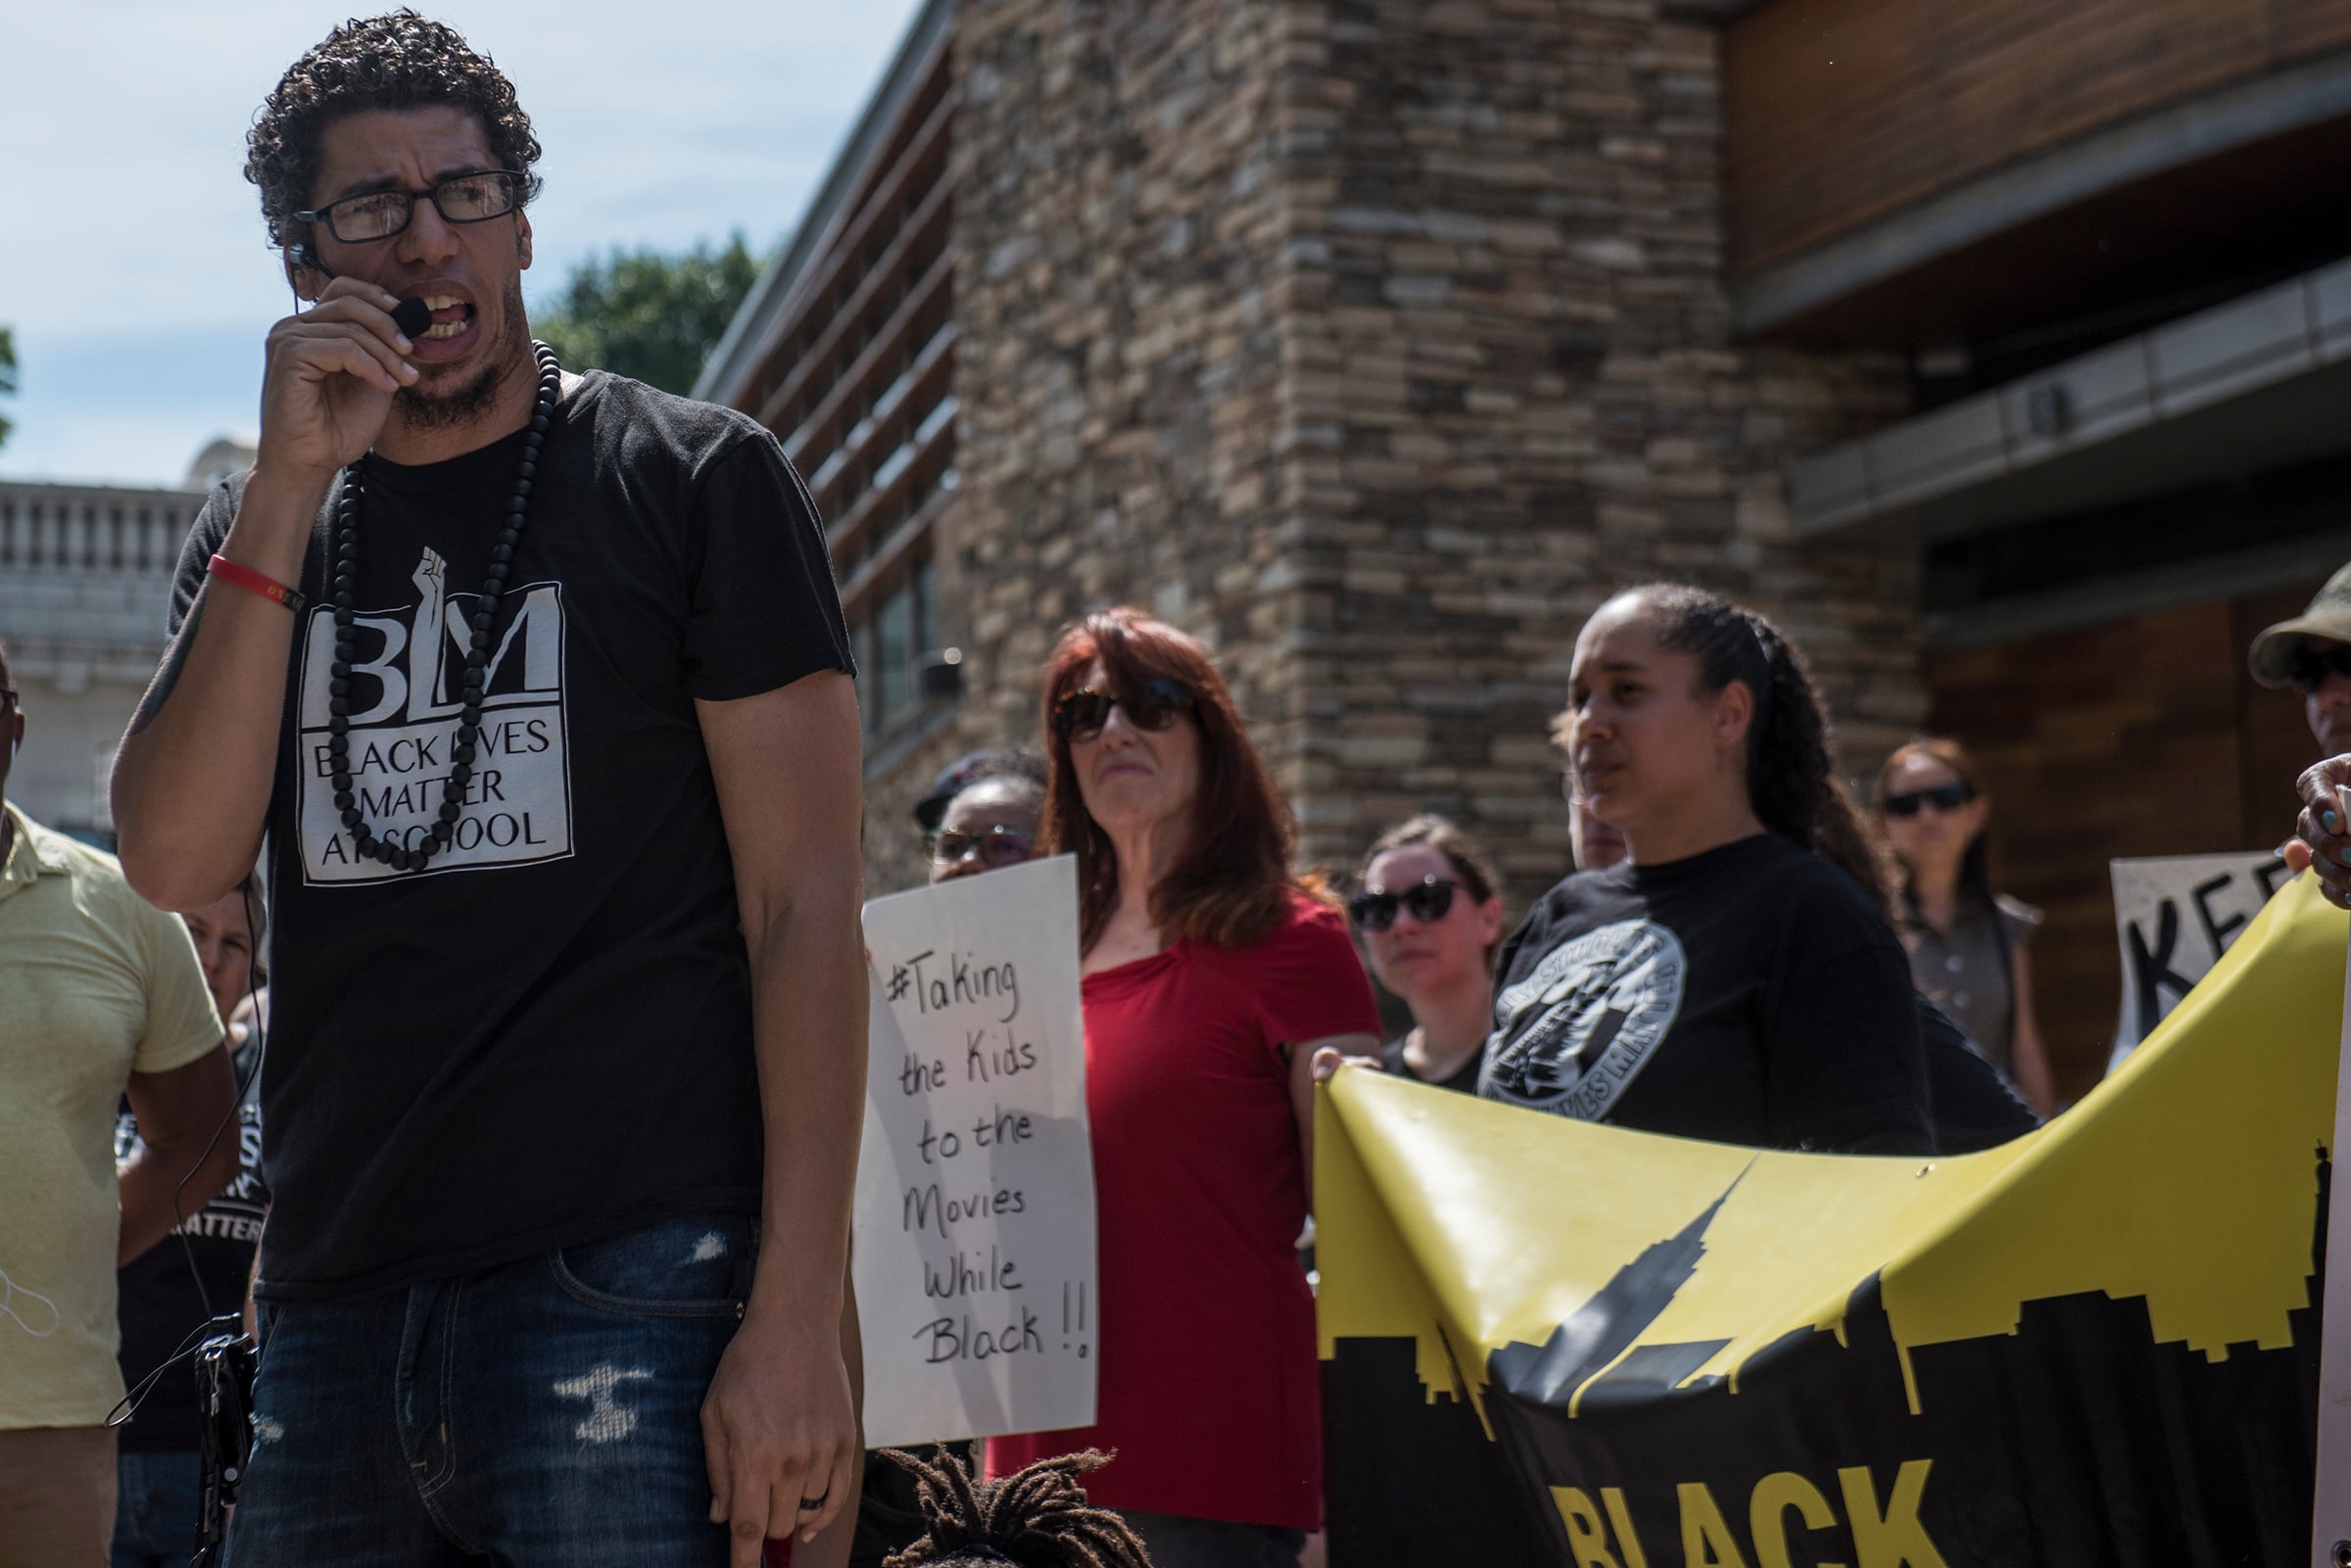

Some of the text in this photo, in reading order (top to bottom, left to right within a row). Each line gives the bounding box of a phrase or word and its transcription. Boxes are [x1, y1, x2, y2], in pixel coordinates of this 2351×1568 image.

[301, 585, 559, 729] BLM
[313, 719, 550, 778] BACK LVES
[381, 812, 547, 855] SCOOL
[887, 950, 1020, 1023] #Taking
[898, 1028, 1037, 1096] the Kids
[917, 1105, 1033, 1164] to the
[903, 1178, 1027, 1239] Movies
[911, 1306, 1044, 1363] Black
